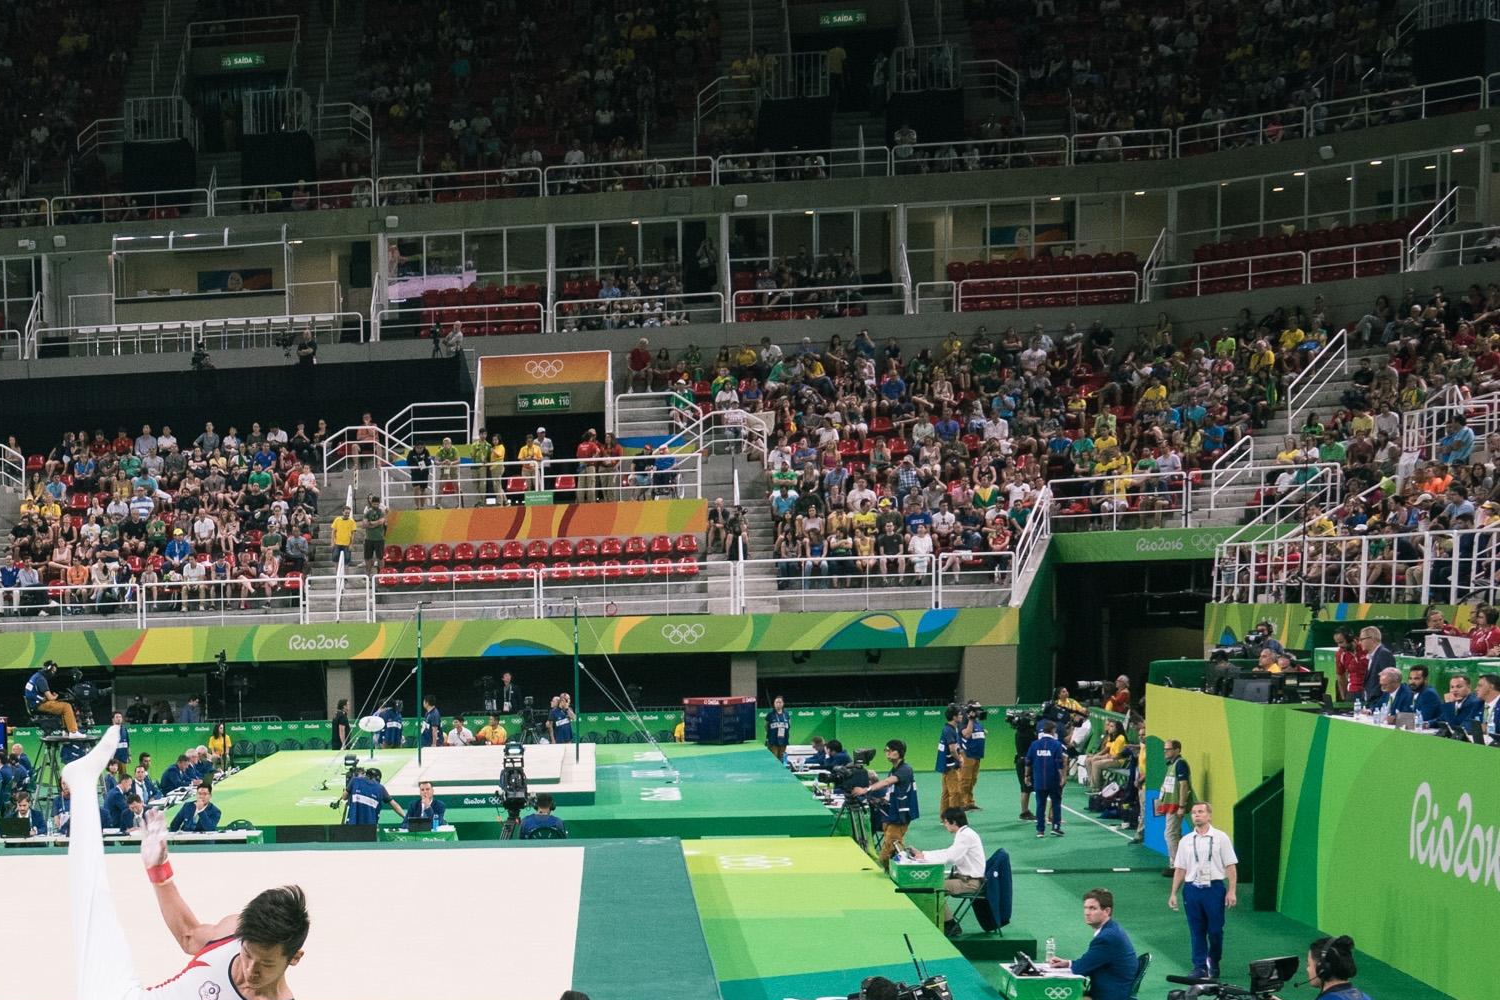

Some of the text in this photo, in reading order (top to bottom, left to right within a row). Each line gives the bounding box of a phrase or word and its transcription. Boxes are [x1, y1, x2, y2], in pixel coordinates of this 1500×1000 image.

[832, 14, 852, 22] SAÍDA
[532, 397, 555, 406] SAÍDA
[1136, 537, 1184, 552] Rio2016
[289, 634, 350, 650] Rio2016
[1410, 782, 1500, 892] Rio201
